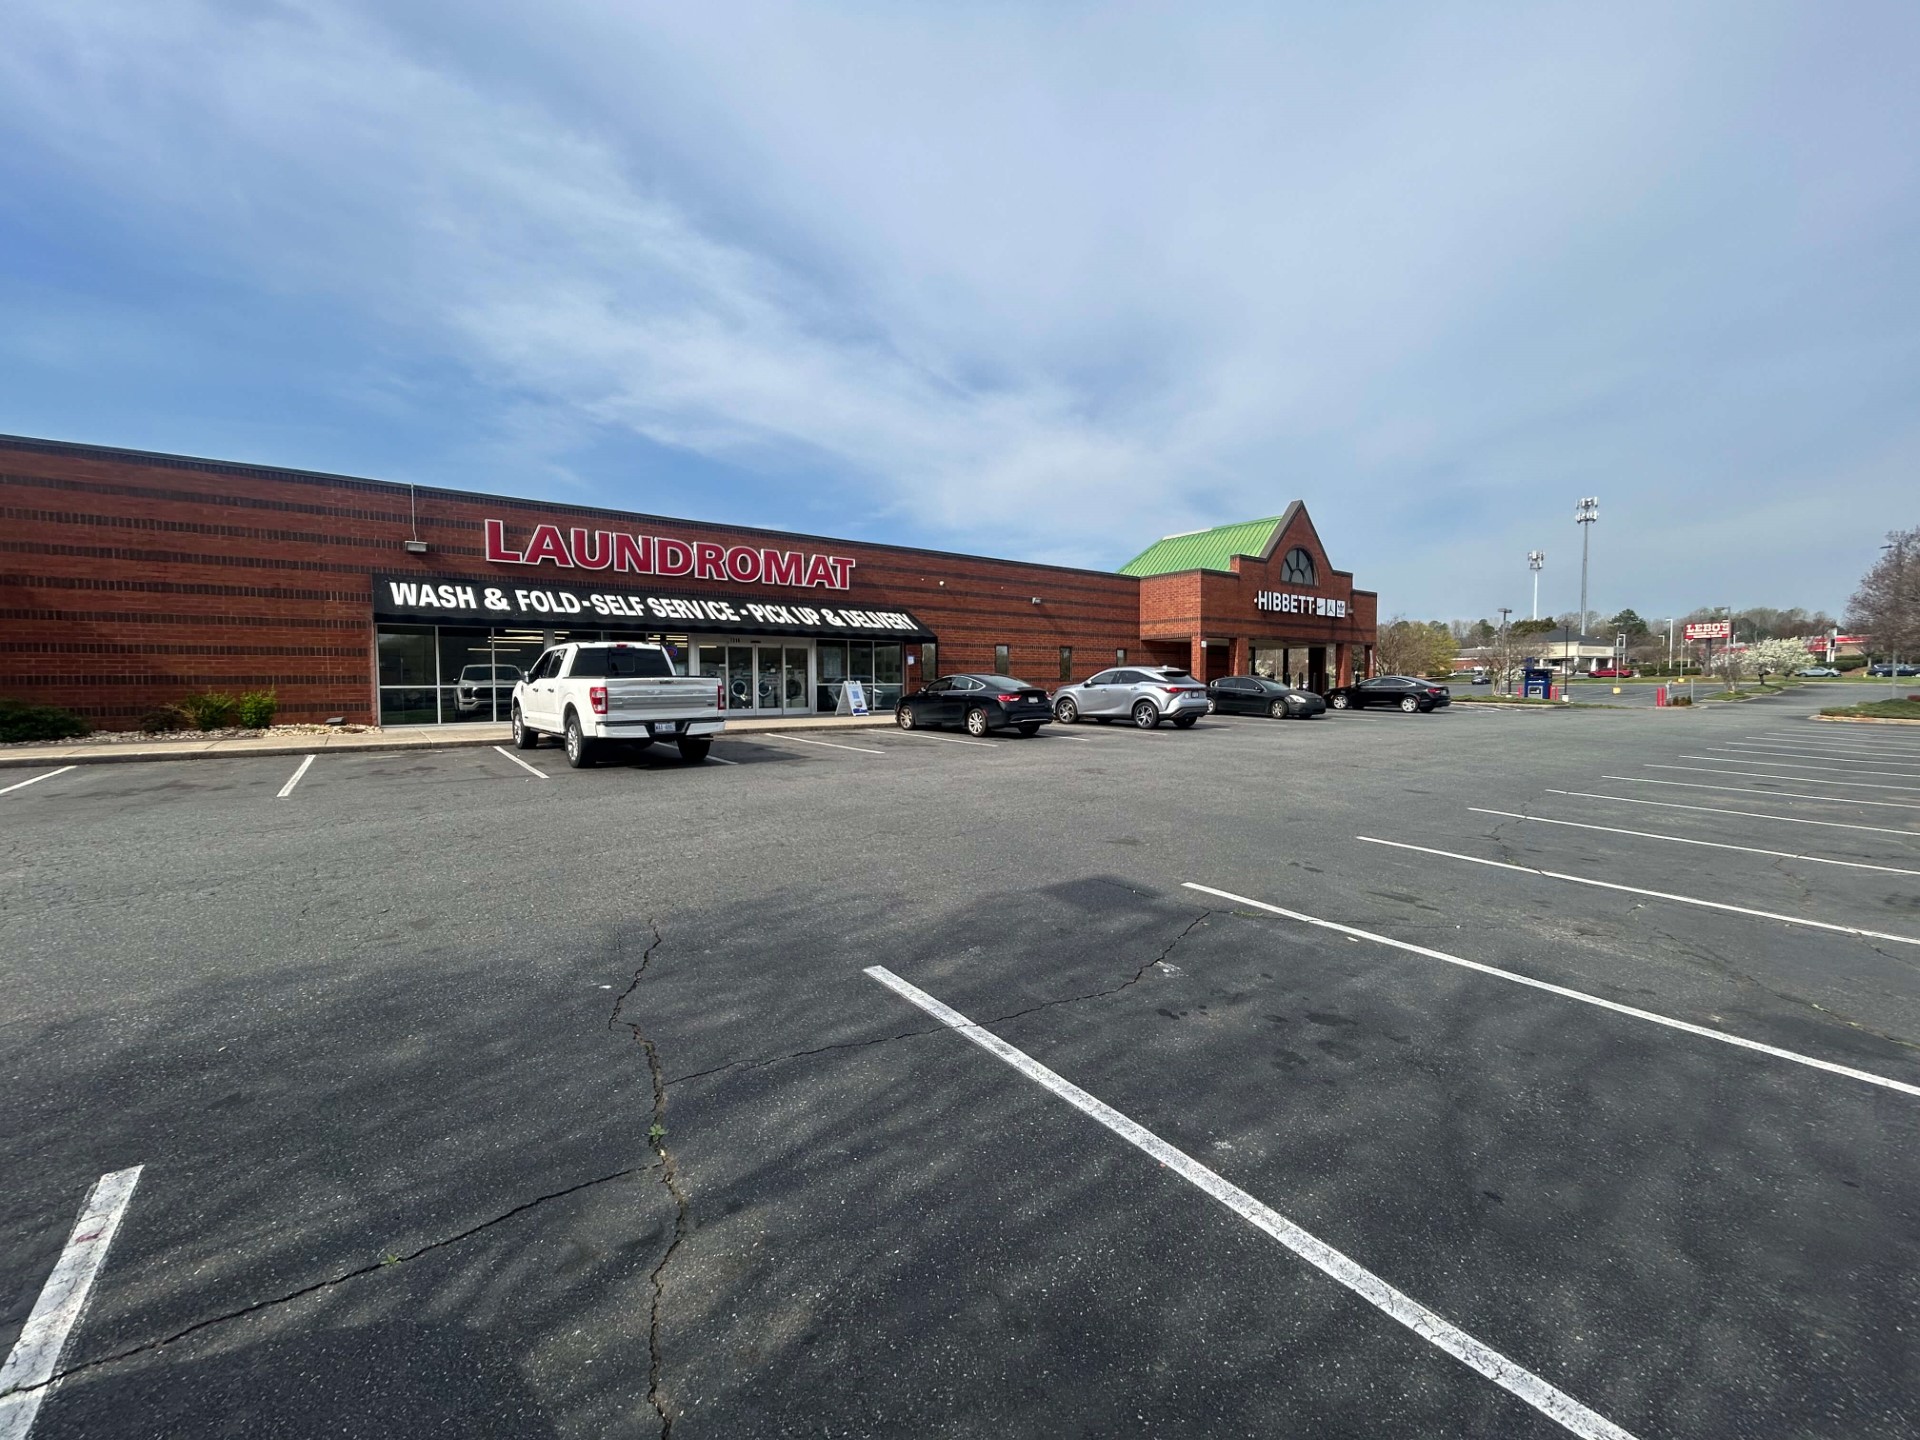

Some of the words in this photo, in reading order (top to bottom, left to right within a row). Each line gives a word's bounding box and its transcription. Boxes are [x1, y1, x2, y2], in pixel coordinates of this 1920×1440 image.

[485, 519, 855, 590] LAUNDROMAT
[389, 582, 477, 609] WASH
[484, 588, 511, 611] &
[646, 597, 741, 622] SERVICE
[746, 603, 800, 625] PICK
[791, 606, 823, 626] UP
[821, 608, 847, 627] &
[838, 609, 919, 631] DELIVERY
[1258, 590, 1314, 614] HIBBETT
